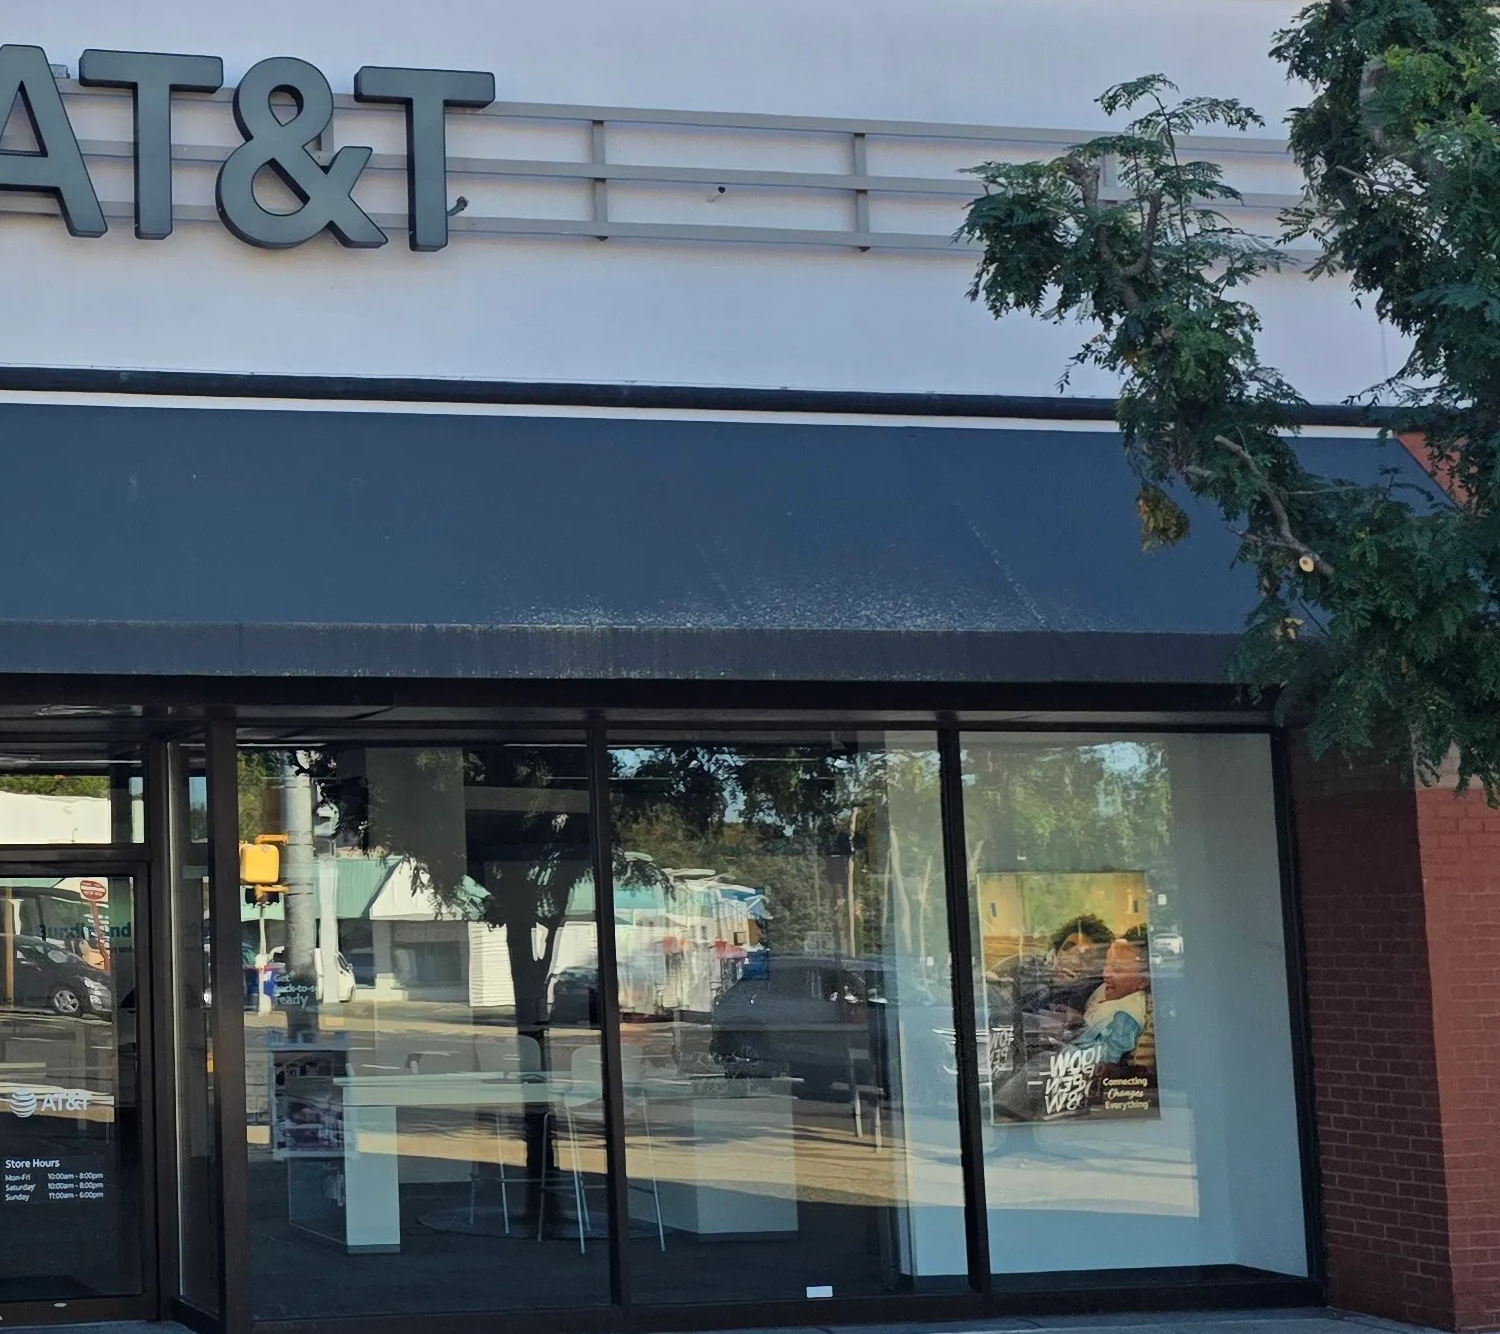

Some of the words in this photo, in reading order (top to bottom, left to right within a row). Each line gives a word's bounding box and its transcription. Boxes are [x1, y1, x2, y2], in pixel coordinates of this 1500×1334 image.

[1102, 1076, 1148, 1087] Connecting
[41, 1093, 91, 1112] AT&T
[1104, 1101, 1149, 1111] Everything
[5, 1159, 31, 1169] Store
[32, 1158, 61, 1168] Hours
[4, 1173, 31, 1182] Mon-Fri
[47, 1172, 75, 1180] 10:00am
[5, 1183, 36, 1192] Saturday
[47, 1182, 75, 1190] 10:00am
[4, 1193, 30, 1202] Sunday
[79, 1191, 104, 1199] 6:00pm
